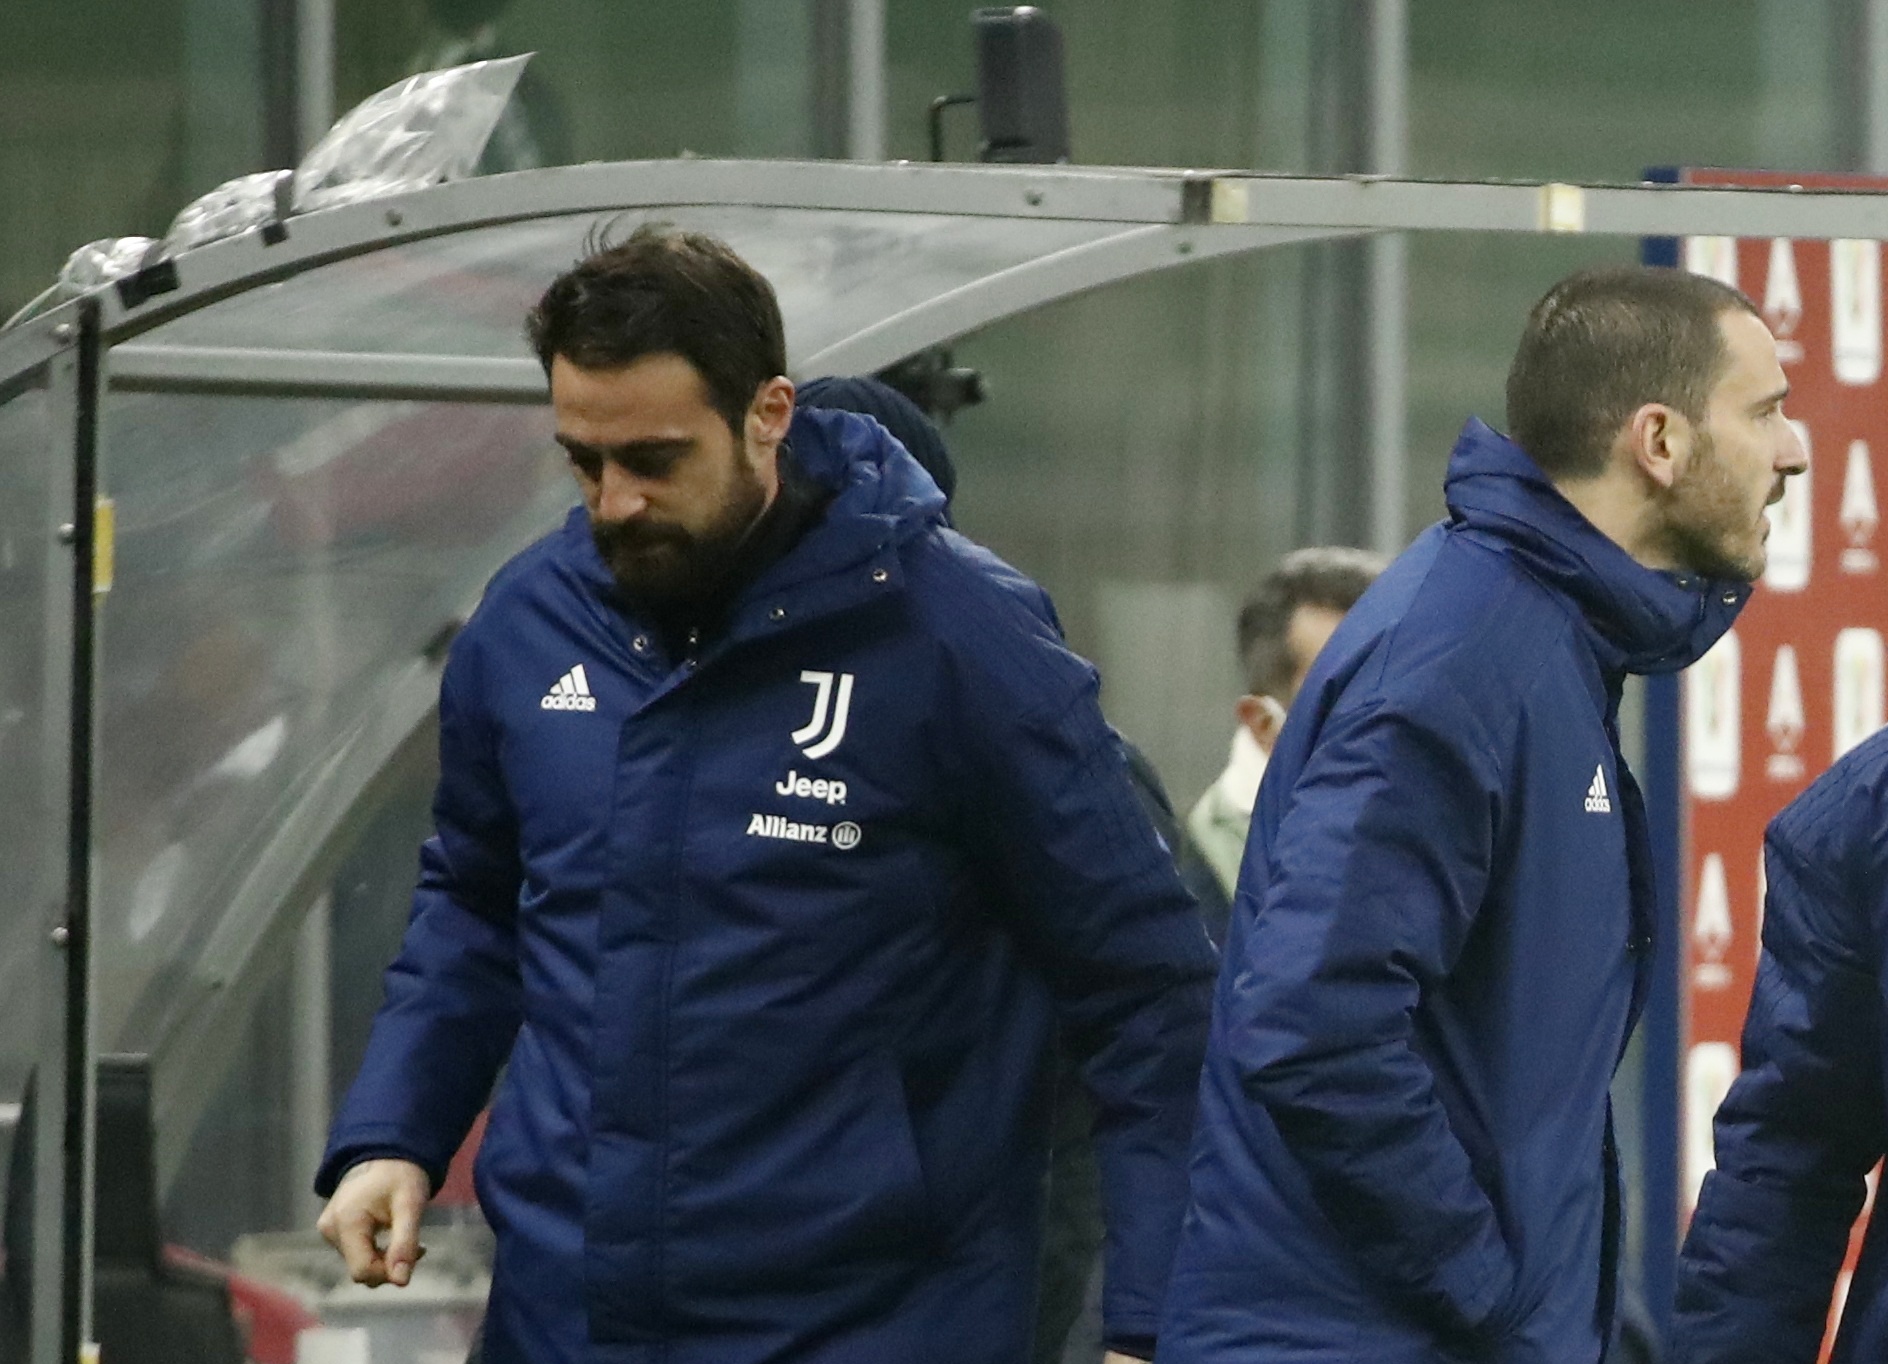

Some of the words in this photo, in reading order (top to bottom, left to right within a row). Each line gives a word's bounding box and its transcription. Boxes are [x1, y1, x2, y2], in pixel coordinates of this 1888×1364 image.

[541, 693, 596, 712] adidas
[775, 770, 848, 804] Jeep
[747, 814, 828, 844] Allianz
